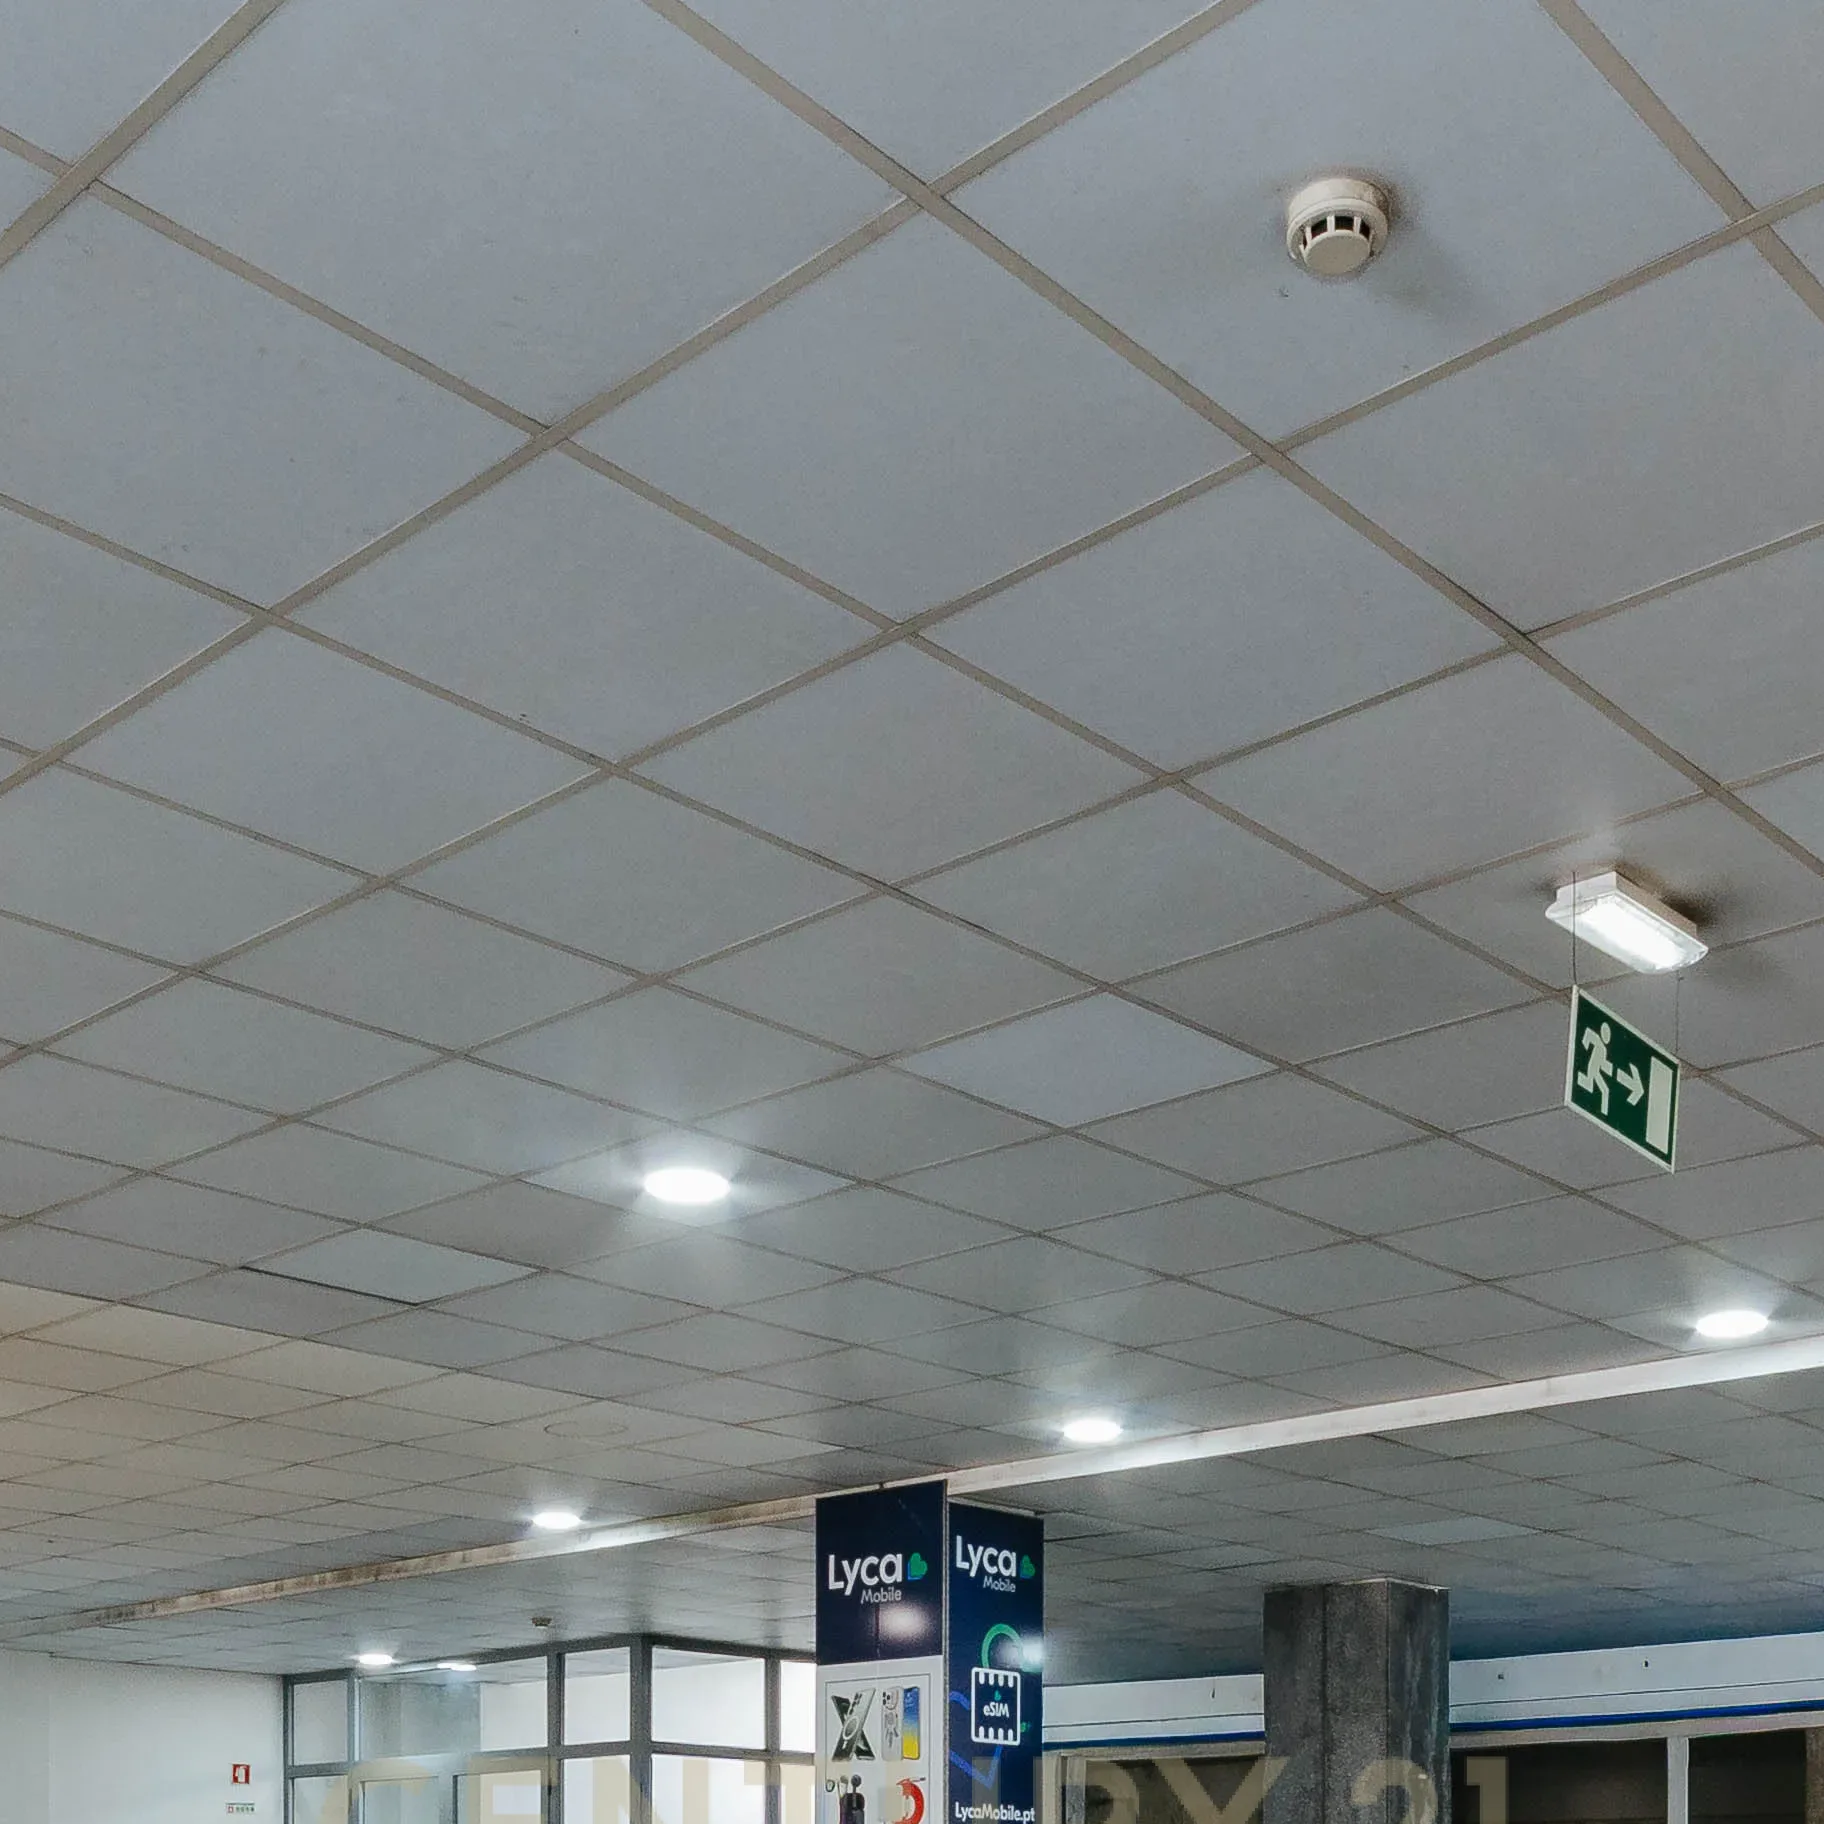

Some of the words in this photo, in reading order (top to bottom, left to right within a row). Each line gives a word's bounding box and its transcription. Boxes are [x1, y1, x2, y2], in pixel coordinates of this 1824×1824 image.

[956, 1535, 1016, 1577] Lyca
[828, 1553, 902, 1596] Lyca
[983, 1575, 1016, 1593] Mobile
[860, 1586, 902, 1605] Mobile
[983, 1702, 1010, 1718] eSIM
[954, 1802, 1036, 1824] LycaMobile.pt
